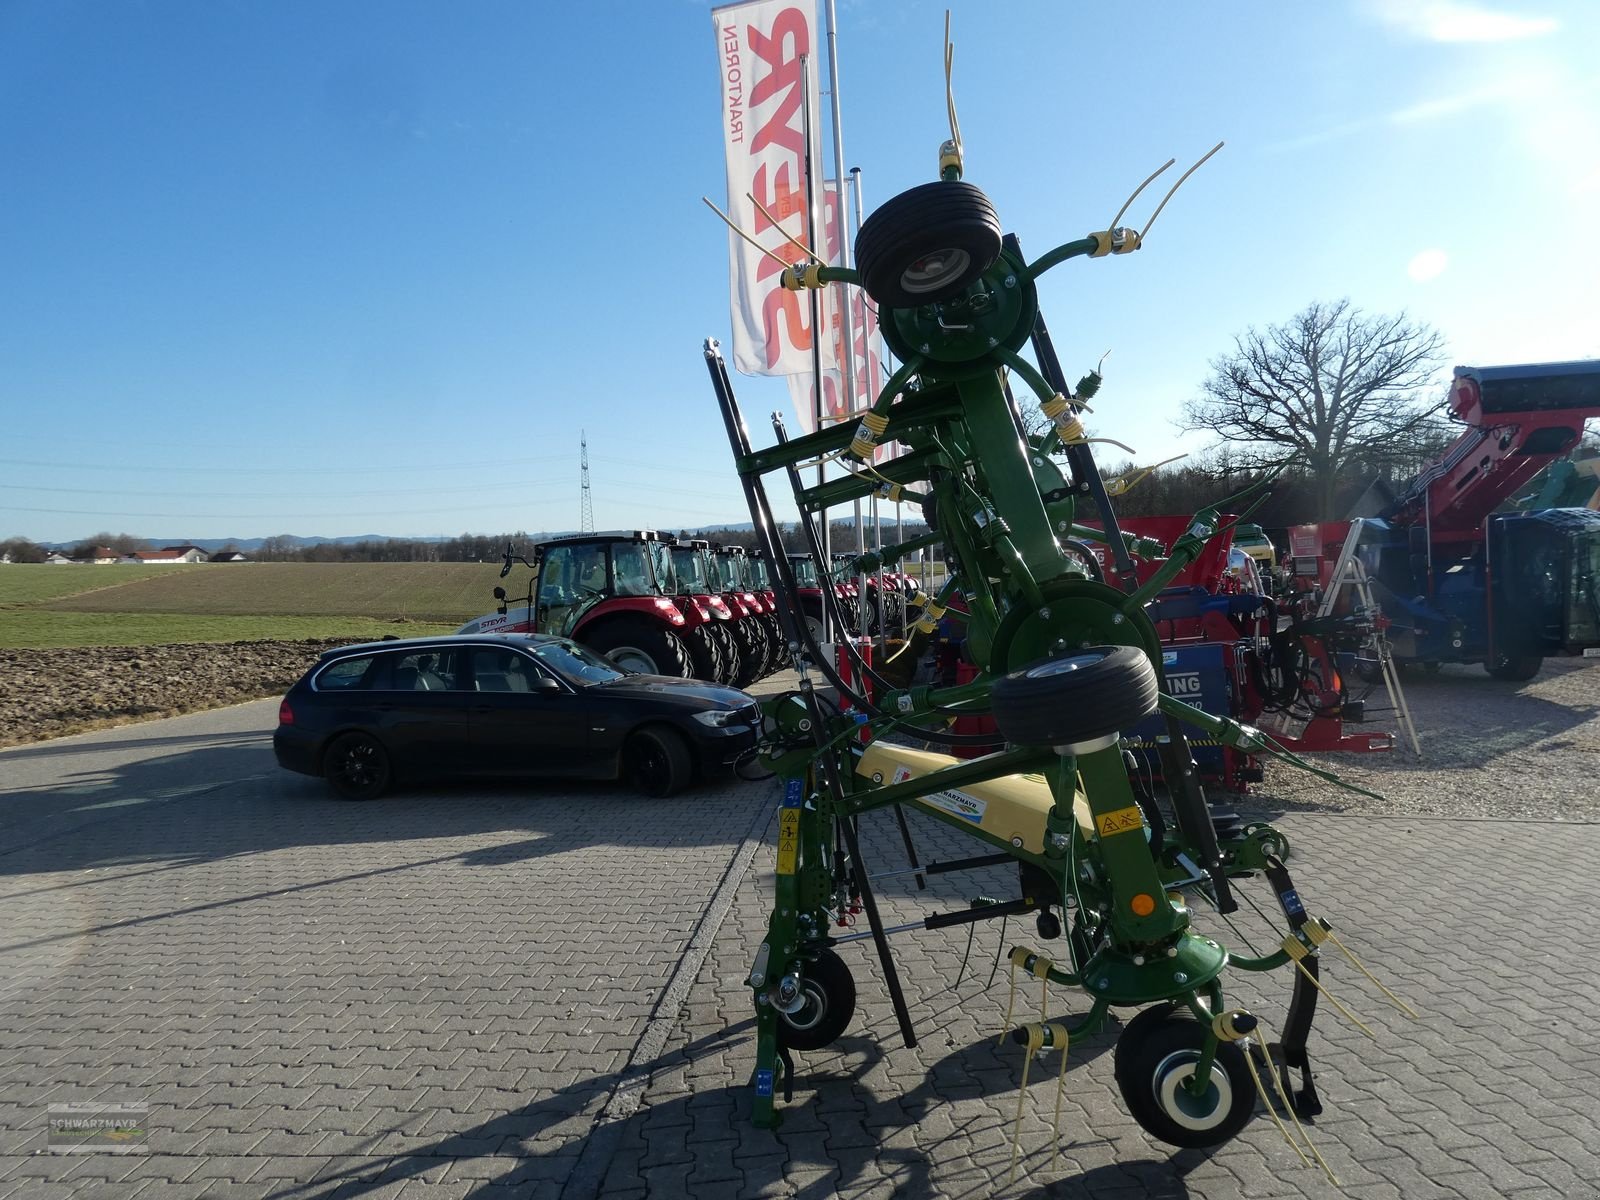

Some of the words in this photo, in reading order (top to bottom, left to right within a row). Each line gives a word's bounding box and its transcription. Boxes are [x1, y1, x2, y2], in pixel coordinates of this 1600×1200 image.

[481, 617, 507, 628] STEYR
[1167, 677, 1200, 694] ING
[940, 791, 977, 808] WARZMAYR
